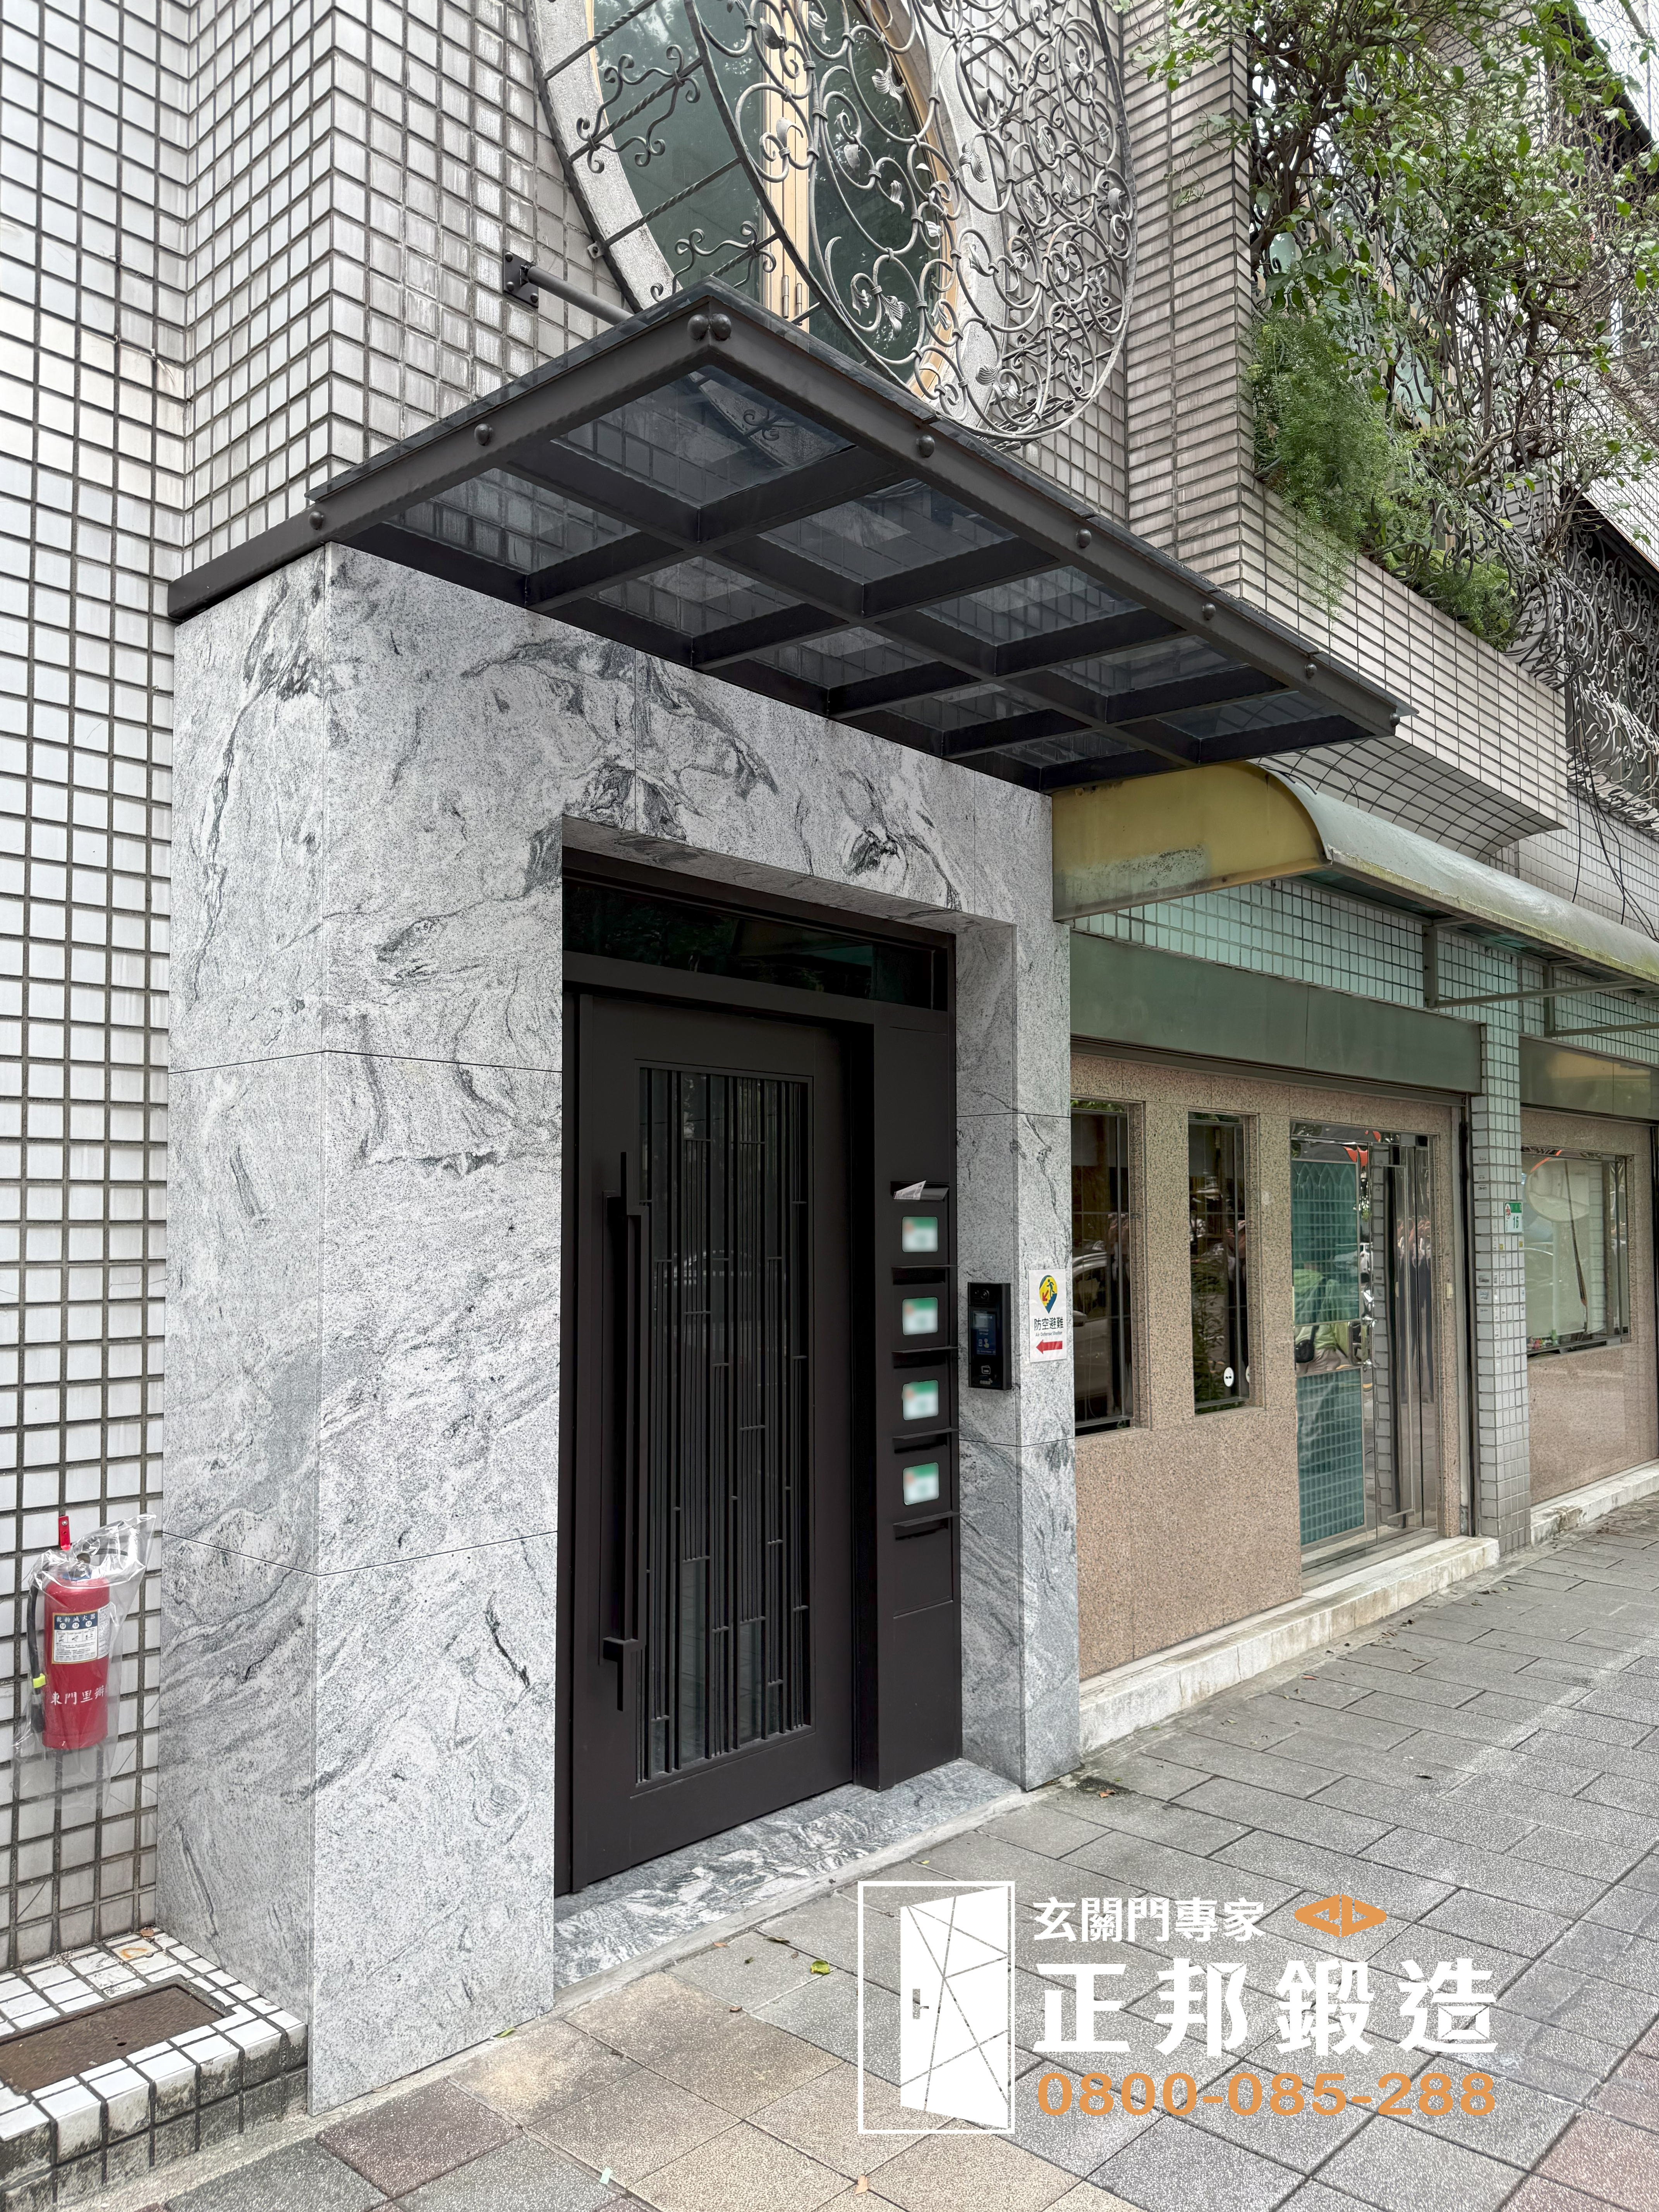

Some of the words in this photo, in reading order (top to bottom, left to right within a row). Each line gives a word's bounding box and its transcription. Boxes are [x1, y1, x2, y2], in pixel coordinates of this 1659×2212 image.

[1513, 1216, 1518, 1228] 16
[1034, 1317, 1064, 1331] 防空避難
[56, 1613, 96, 1623] 乾粉滅火器
